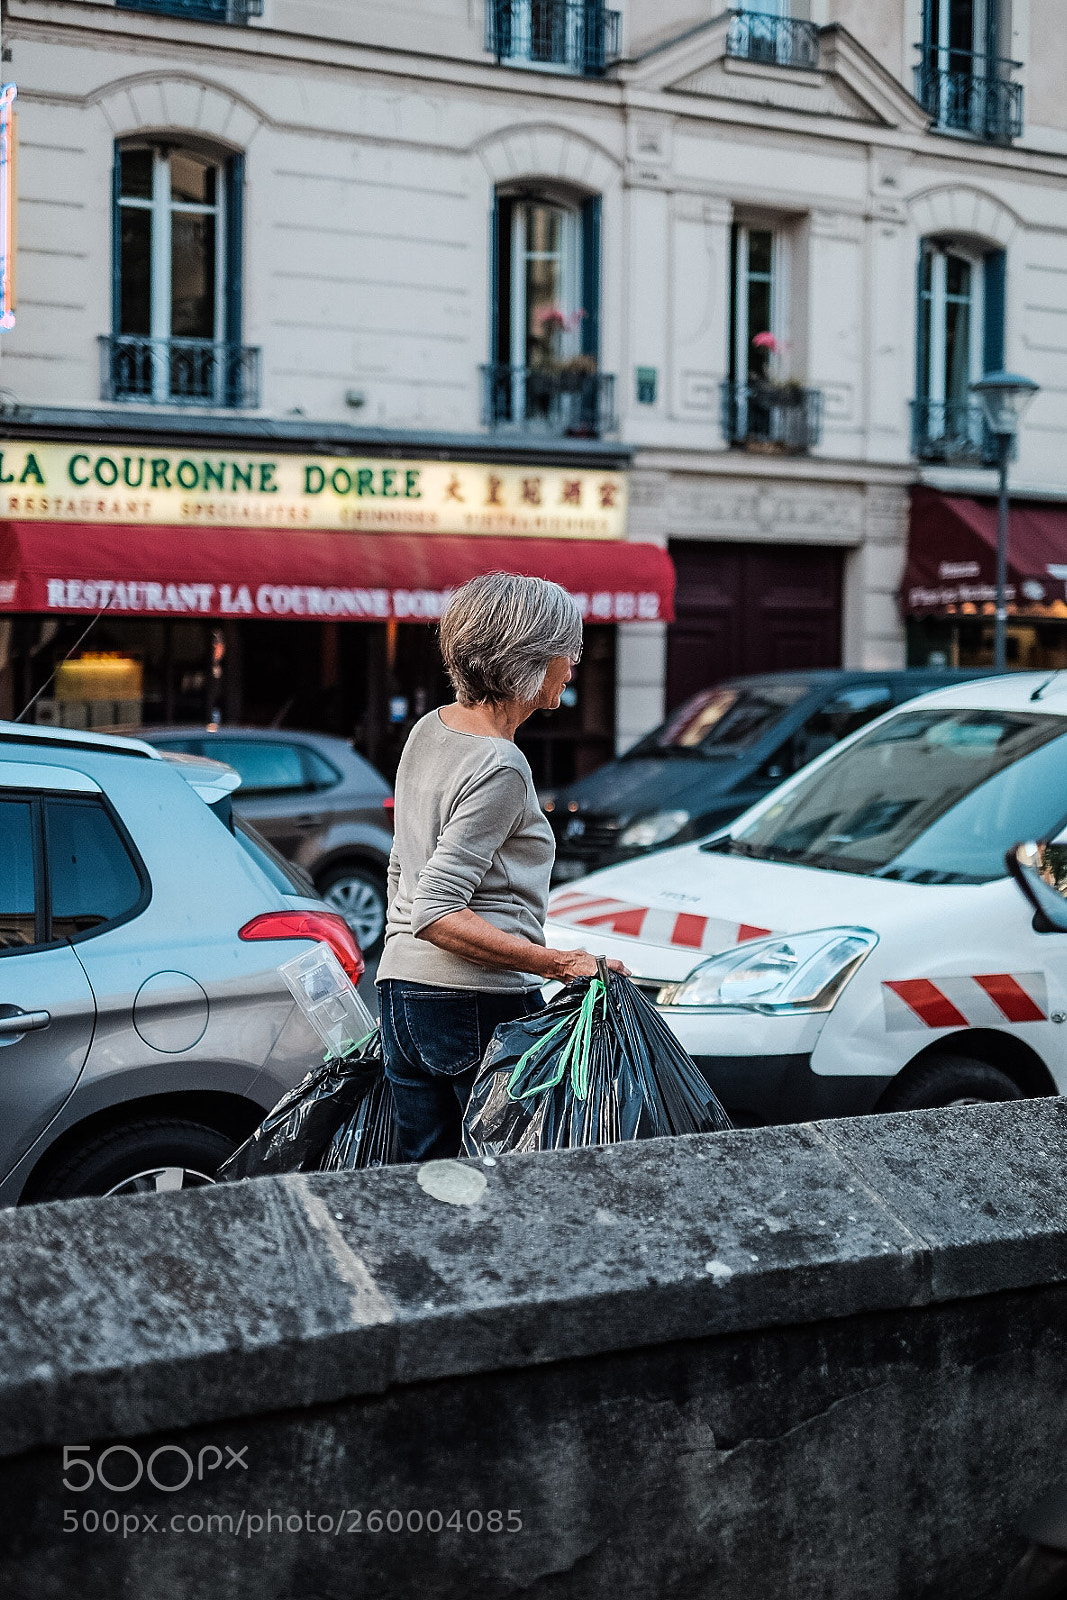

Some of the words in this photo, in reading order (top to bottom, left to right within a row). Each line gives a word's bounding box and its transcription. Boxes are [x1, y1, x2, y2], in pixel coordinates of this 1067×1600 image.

[0, 452, 45, 486] LA
[67, 453, 279, 494] COURONNE
[304, 464, 422, 499] DOREE
[8, 497, 151, 520] RESTAURANT
[47, 578, 214, 613] RESTAURANT
[218, 583, 252, 613] LA
[256, 584, 390, 617] COURONNE
